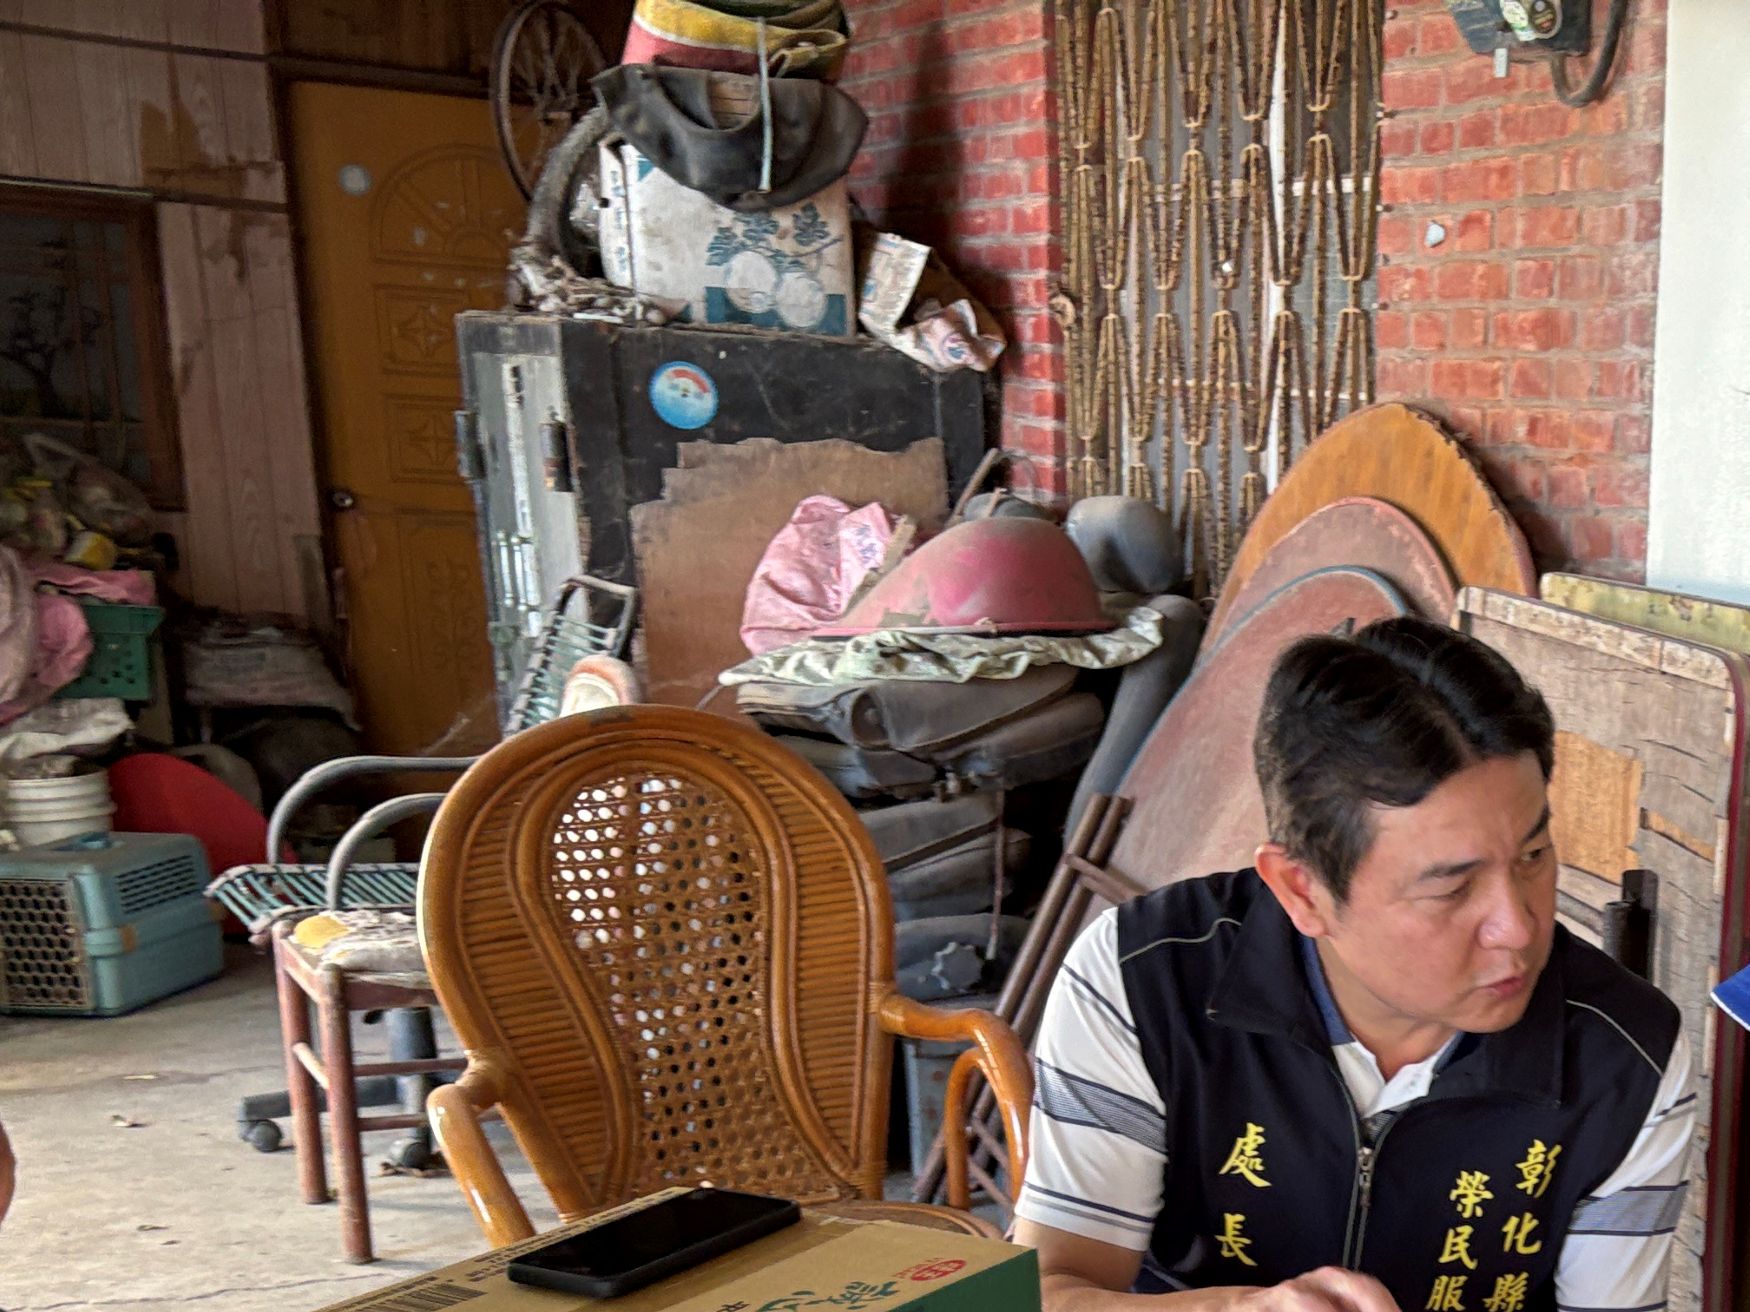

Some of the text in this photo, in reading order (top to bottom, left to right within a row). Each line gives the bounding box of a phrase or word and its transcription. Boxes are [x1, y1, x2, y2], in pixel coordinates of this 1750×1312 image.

[1215, 1122, 1272, 1267] 處長
[1425, 1170, 1494, 1312] 榮民服
